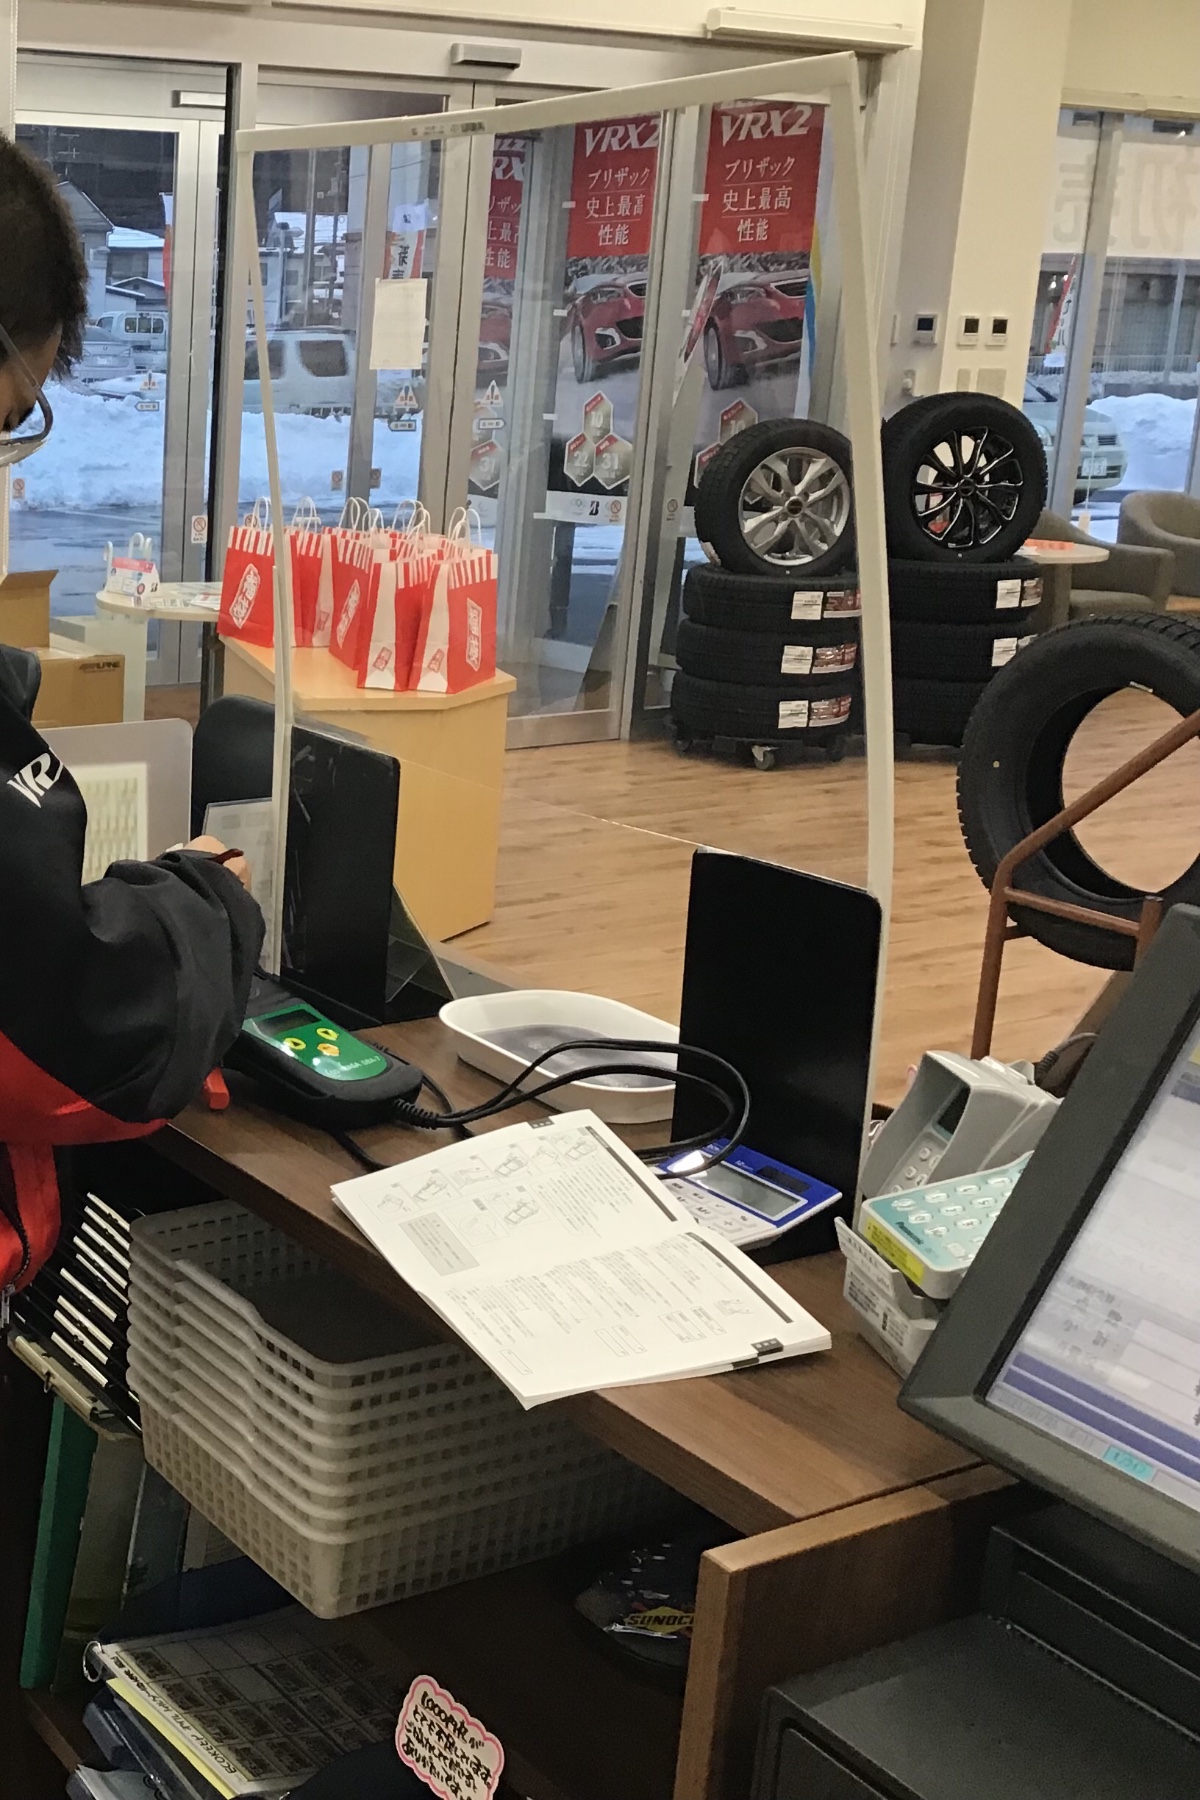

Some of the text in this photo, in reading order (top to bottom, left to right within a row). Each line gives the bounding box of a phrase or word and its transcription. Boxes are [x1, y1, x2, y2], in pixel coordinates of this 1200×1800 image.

[584, 114, 660, 158] VRX2
[721, 104, 813, 147] VRX2
[588, 167, 650, 190] ブリザック
[725, 156, 796, 178] ブリザック
[585, 194, 646, 219] 史上最高
[722, 186, 792, 213] 史上最高
[487, 220, 520, 243] 上最
[598, 223, 630, 247] 性能
[736, 218, 770, 242] 性能
[6, 752, 64, 808] VR
